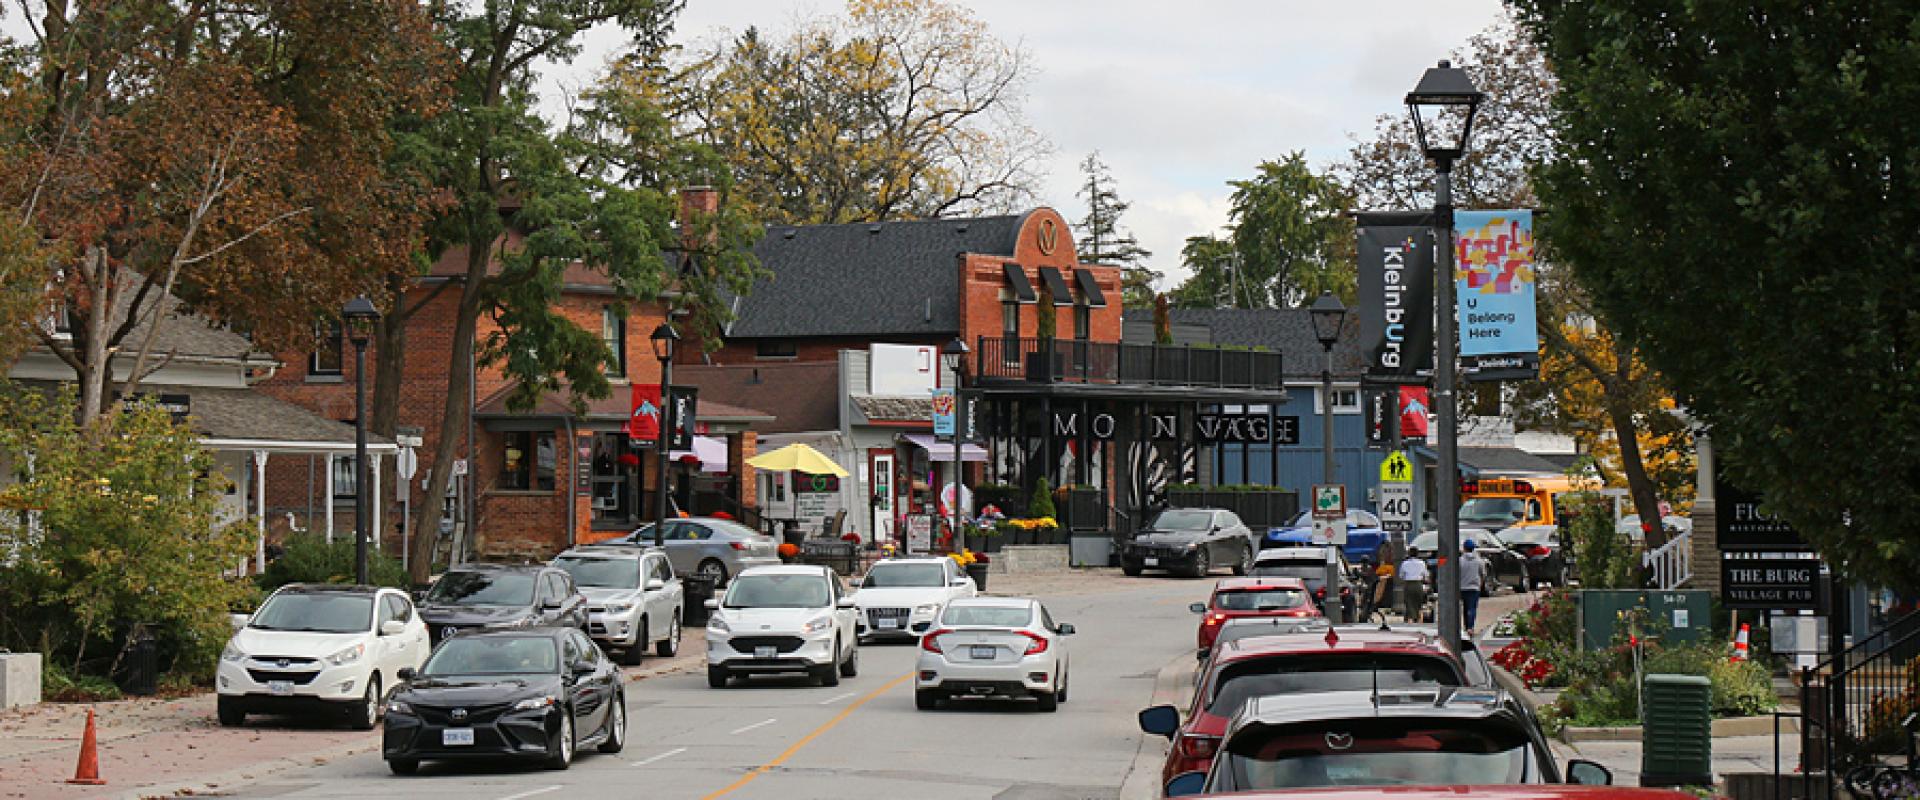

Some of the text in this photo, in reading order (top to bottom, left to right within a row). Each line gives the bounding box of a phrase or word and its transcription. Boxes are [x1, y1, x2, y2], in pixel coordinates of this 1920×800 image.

[1467, 311, 1516, 324] Belong
[1469, 326, 1501, 339] Here
[1383, 498, 1411, 516] 40
[1730, 568, 1810, 582] THE BURG
[1730, 590, 1812, 600] VILLAGE PUB
